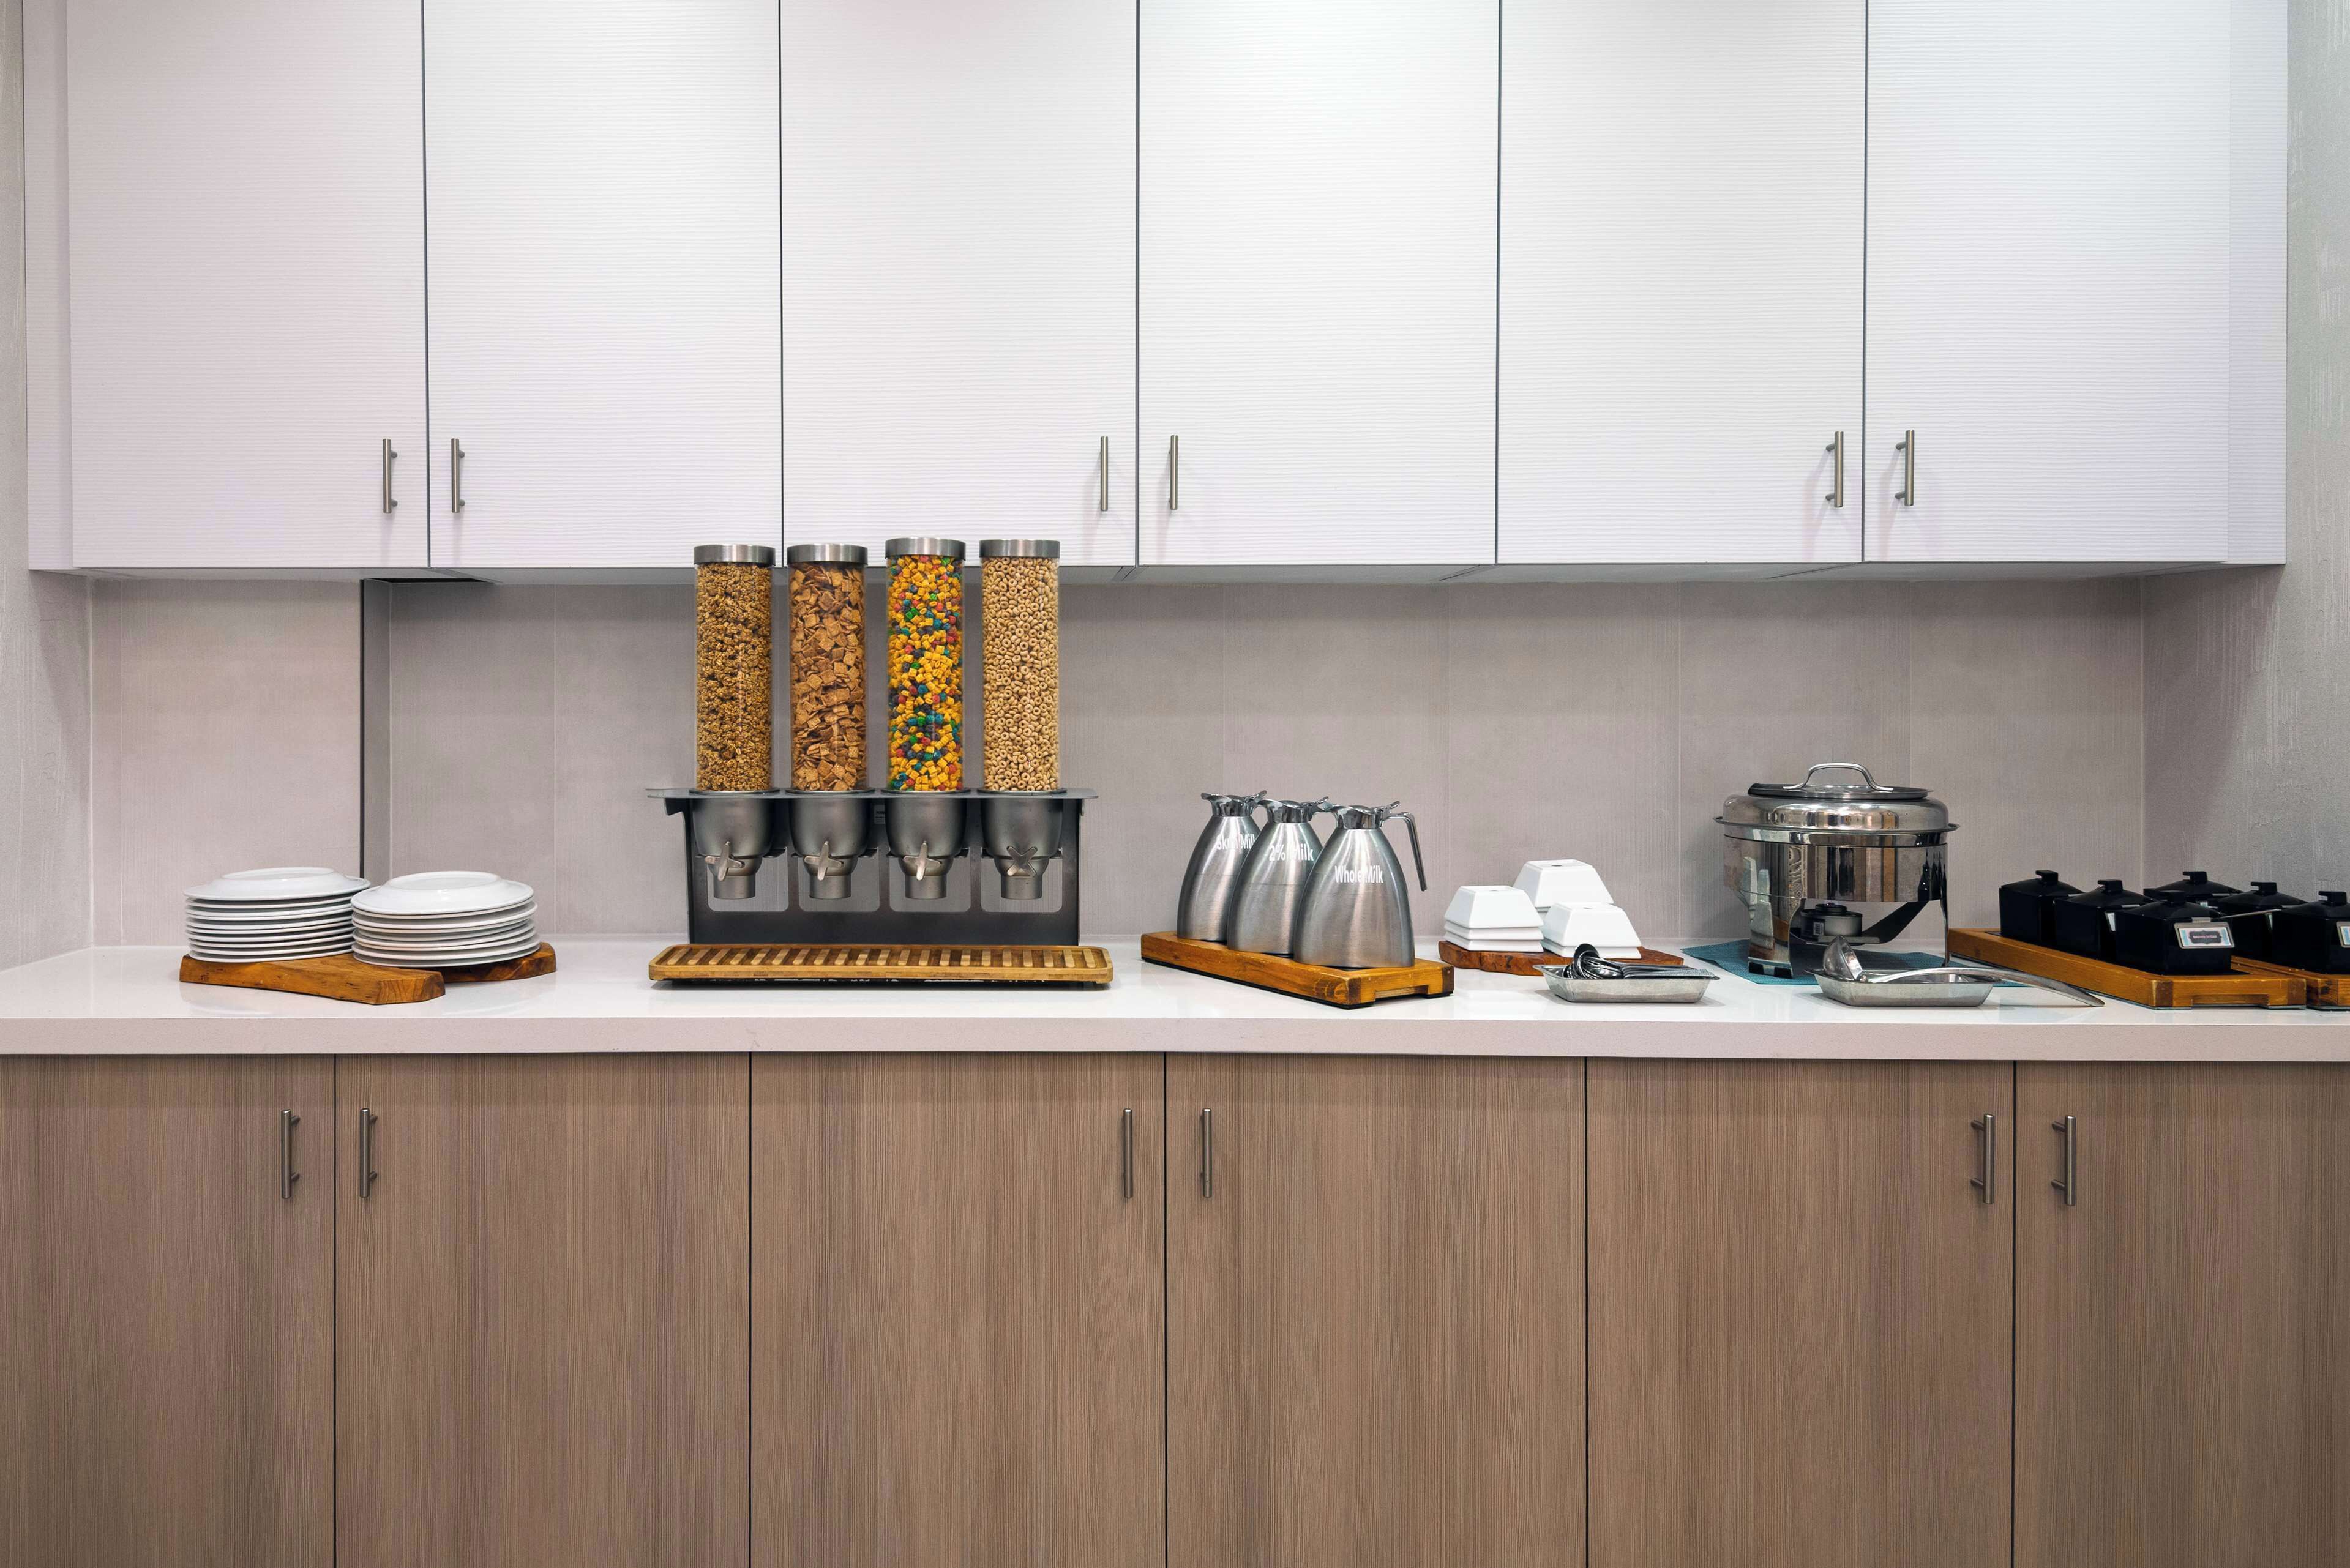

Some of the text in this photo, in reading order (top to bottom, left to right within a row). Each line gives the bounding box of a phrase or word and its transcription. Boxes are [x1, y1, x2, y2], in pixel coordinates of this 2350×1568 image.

[1269, 844, 1285, 861] 2%
[1334, 865, 1383, 883] Whole Milk
